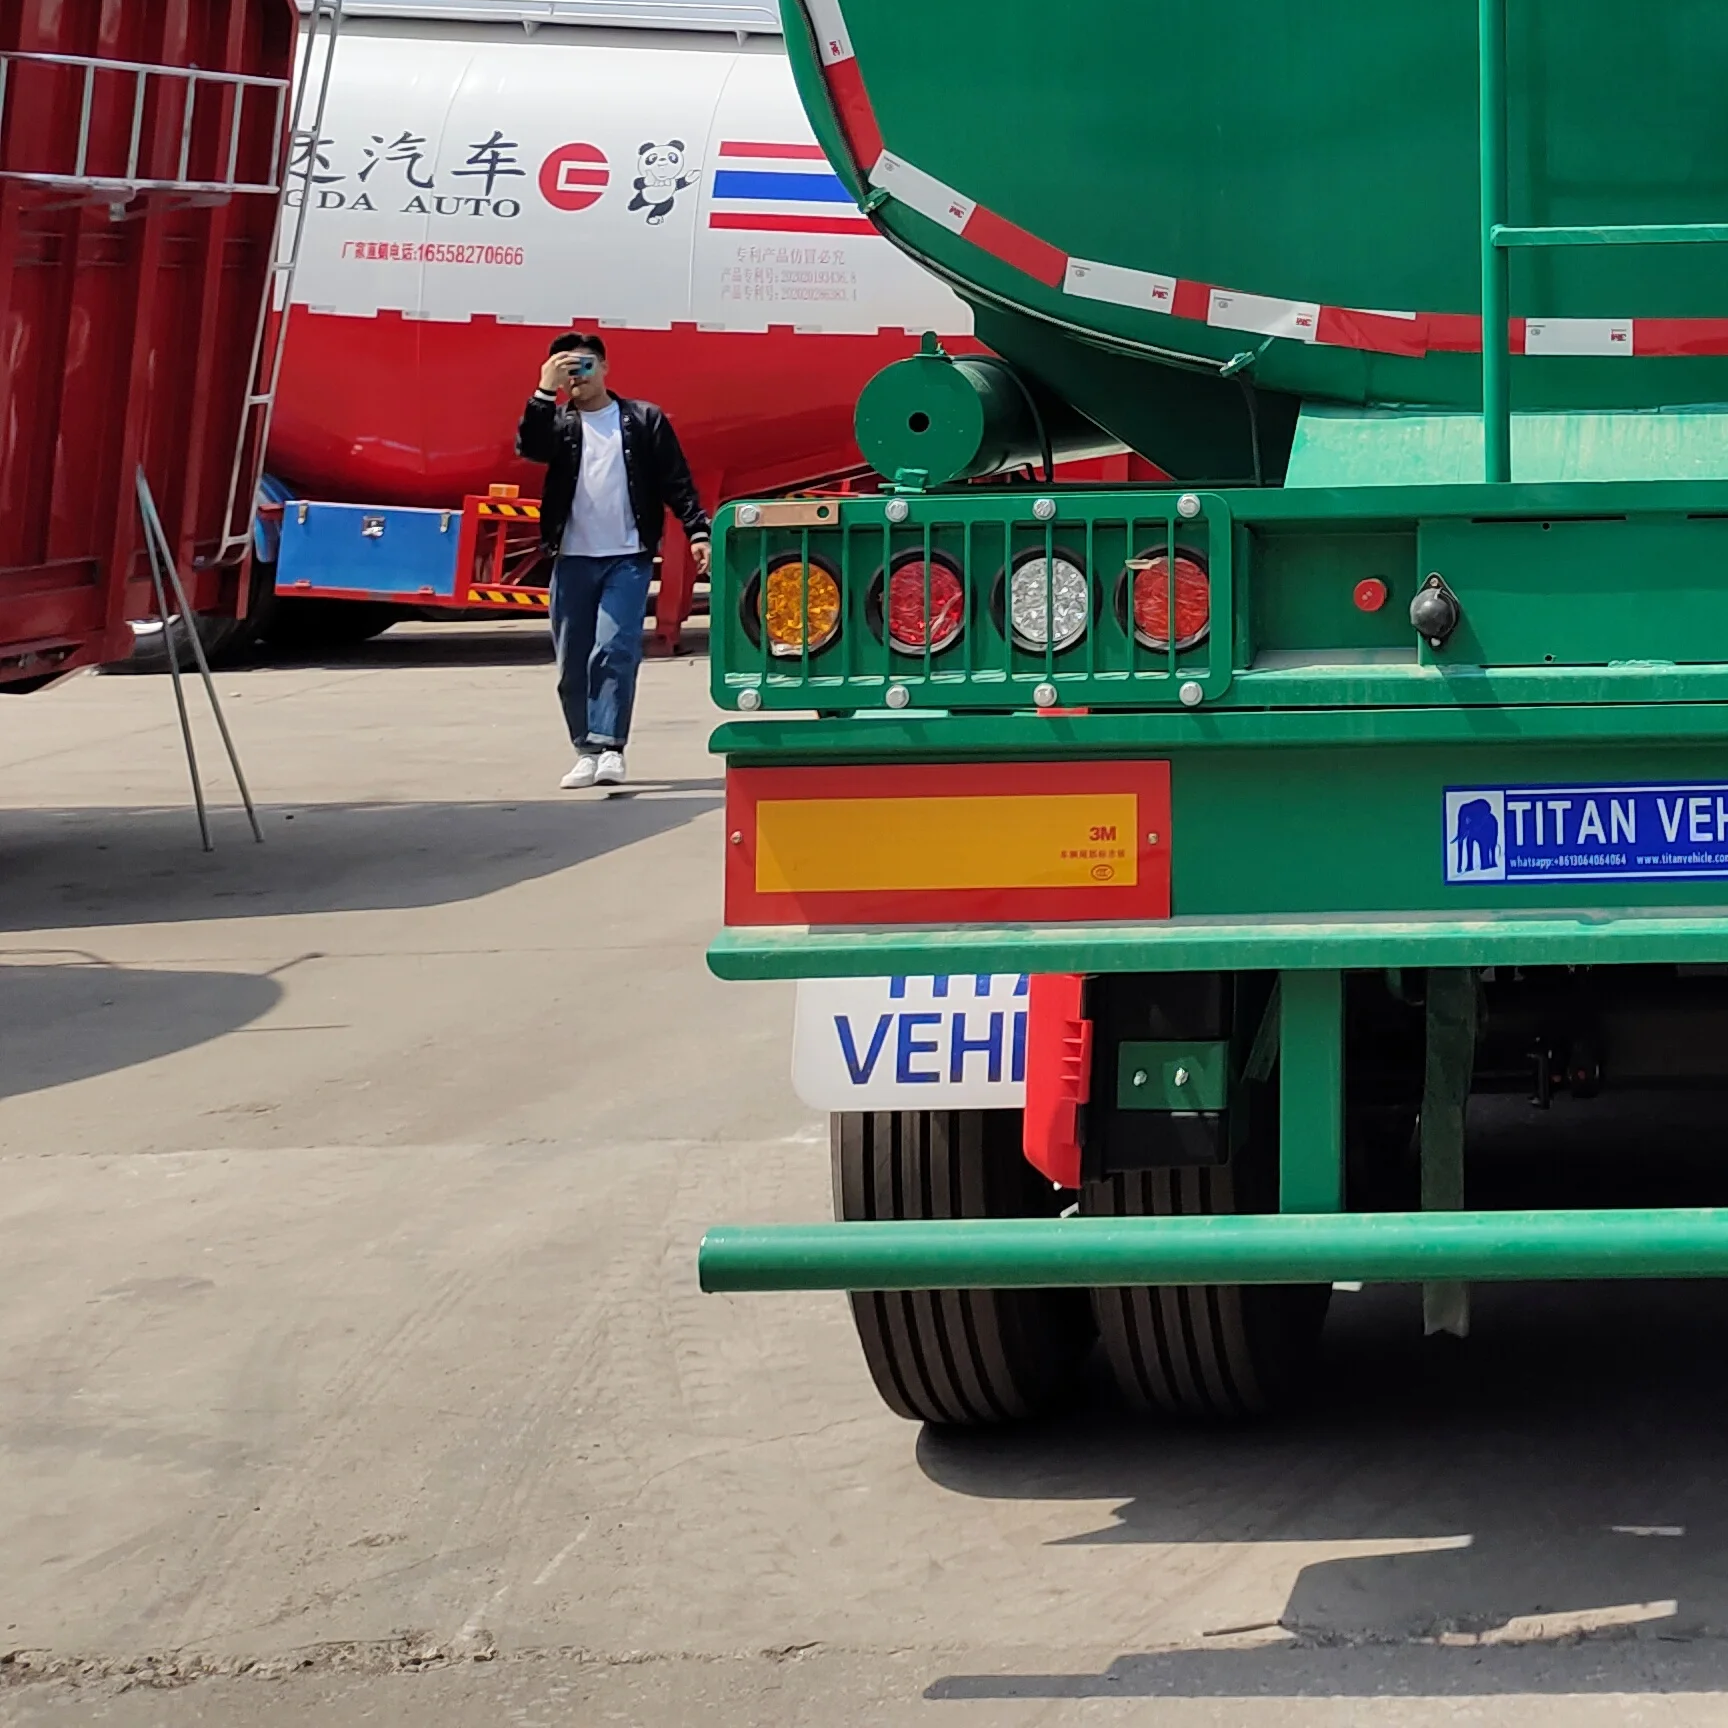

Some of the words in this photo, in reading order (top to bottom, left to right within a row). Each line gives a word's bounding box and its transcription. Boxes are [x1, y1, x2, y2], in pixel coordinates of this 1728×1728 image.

[400, 195, 521, 218] AUTO
[1507, 797, 1636, 846] TITAN
[1089, 826, 1116, 841] 3M
